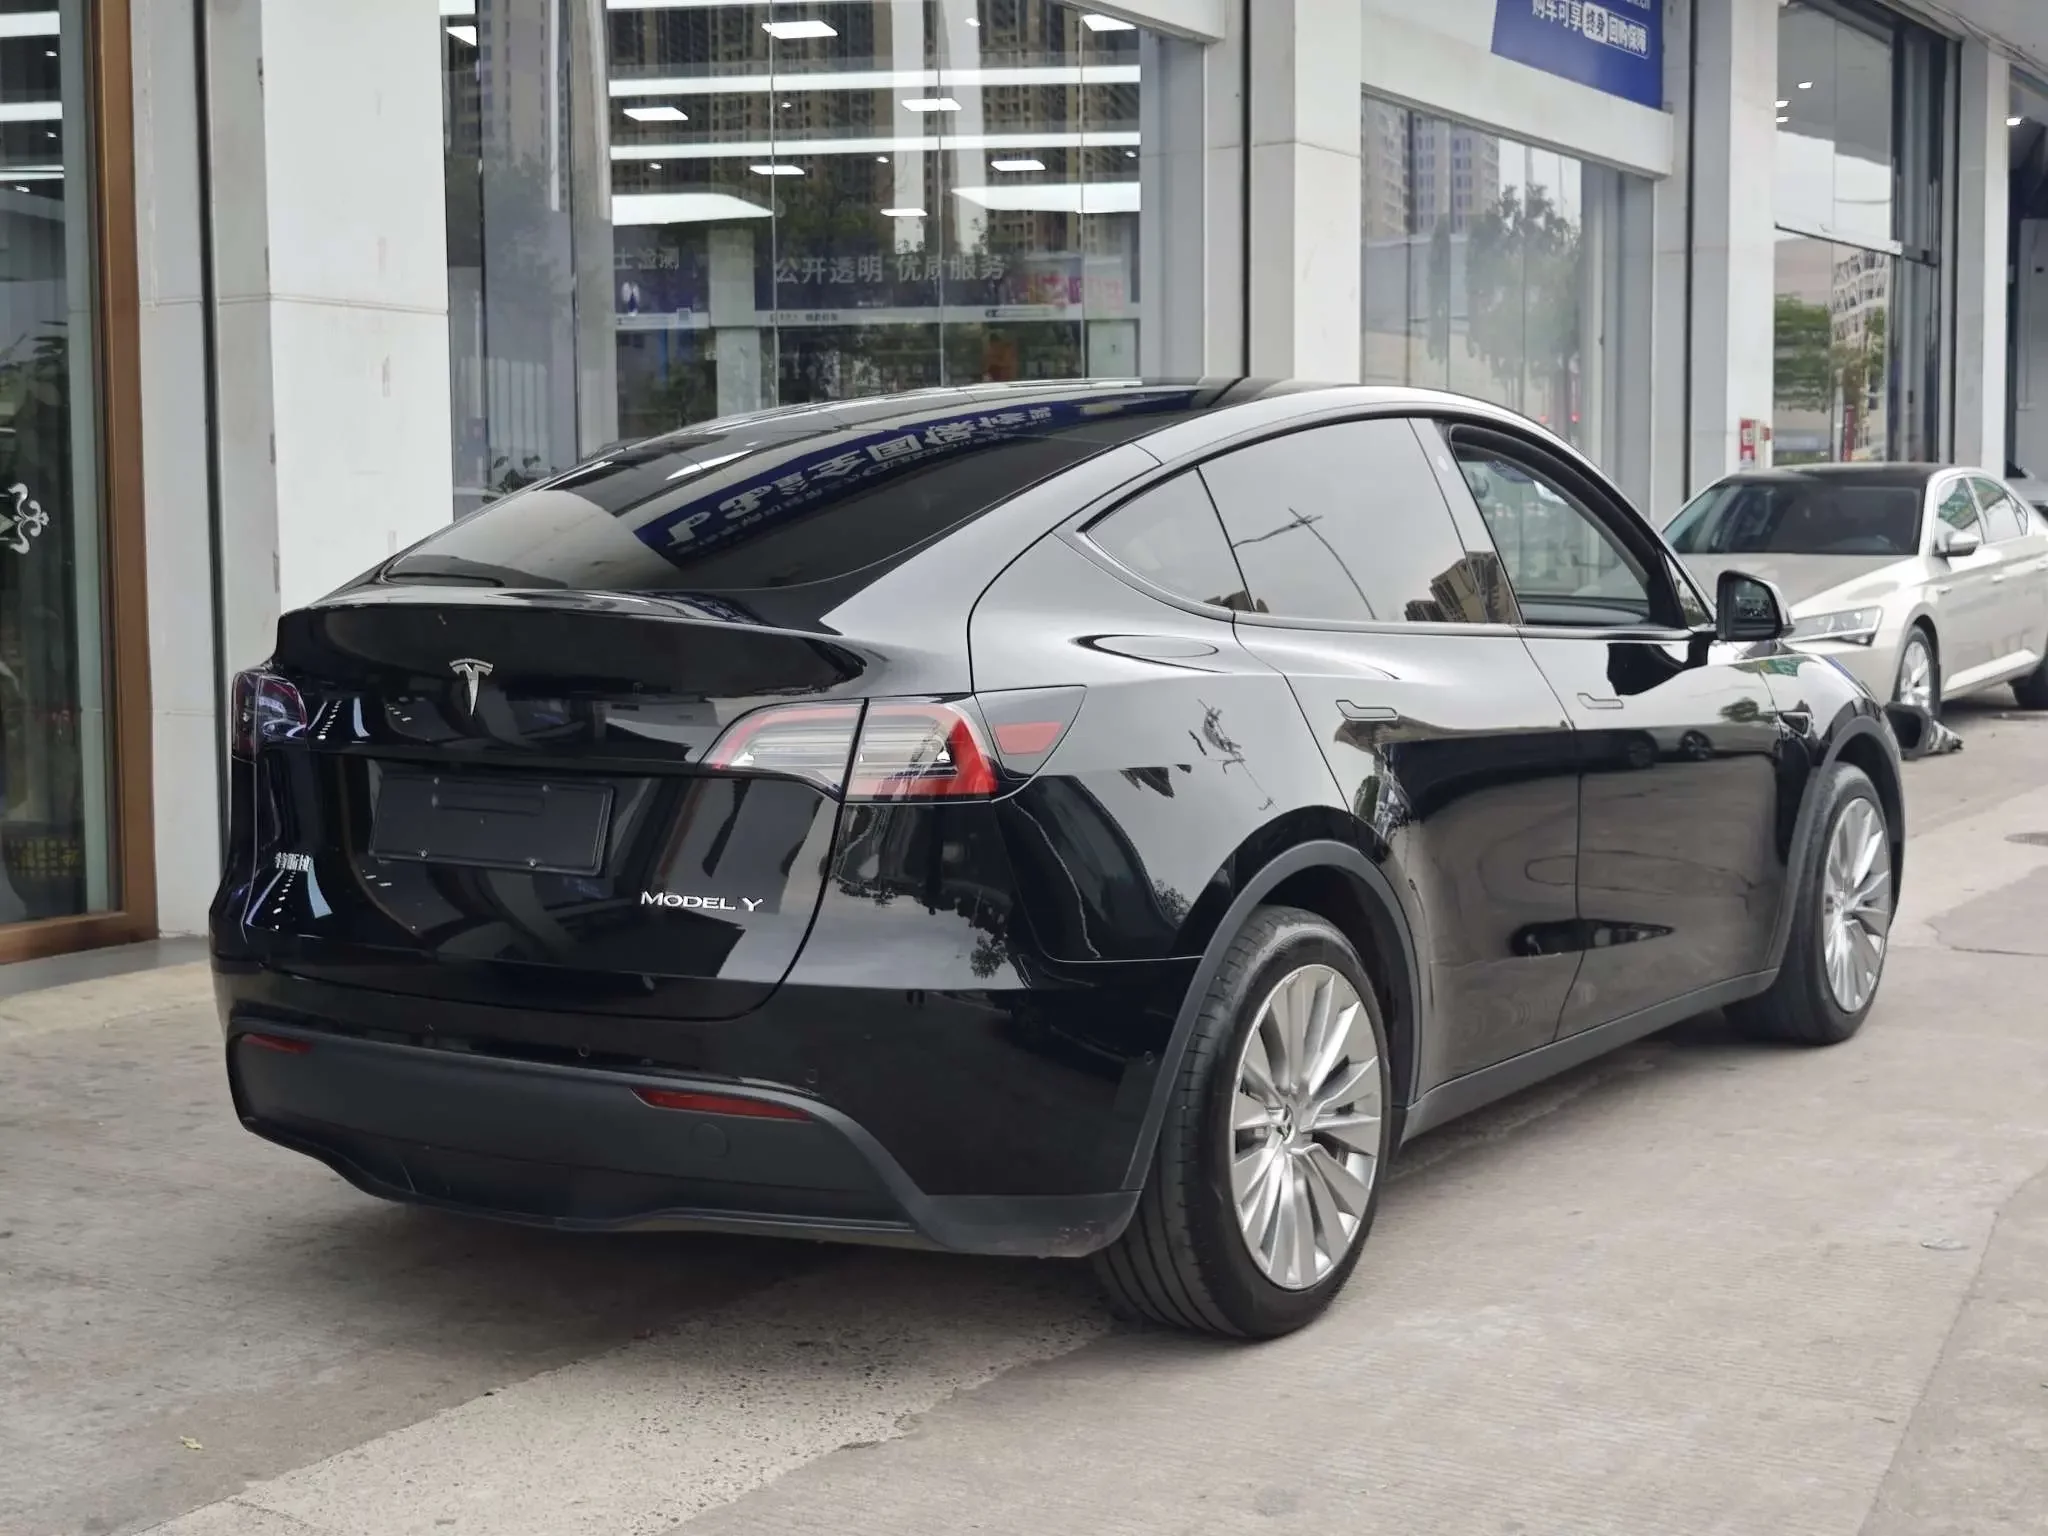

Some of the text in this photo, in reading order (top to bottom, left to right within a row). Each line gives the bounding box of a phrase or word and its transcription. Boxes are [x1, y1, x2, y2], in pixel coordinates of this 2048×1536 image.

[776, 255, 884, 284] 公开透明
[641, 891, 763, 912] MODEL Y
